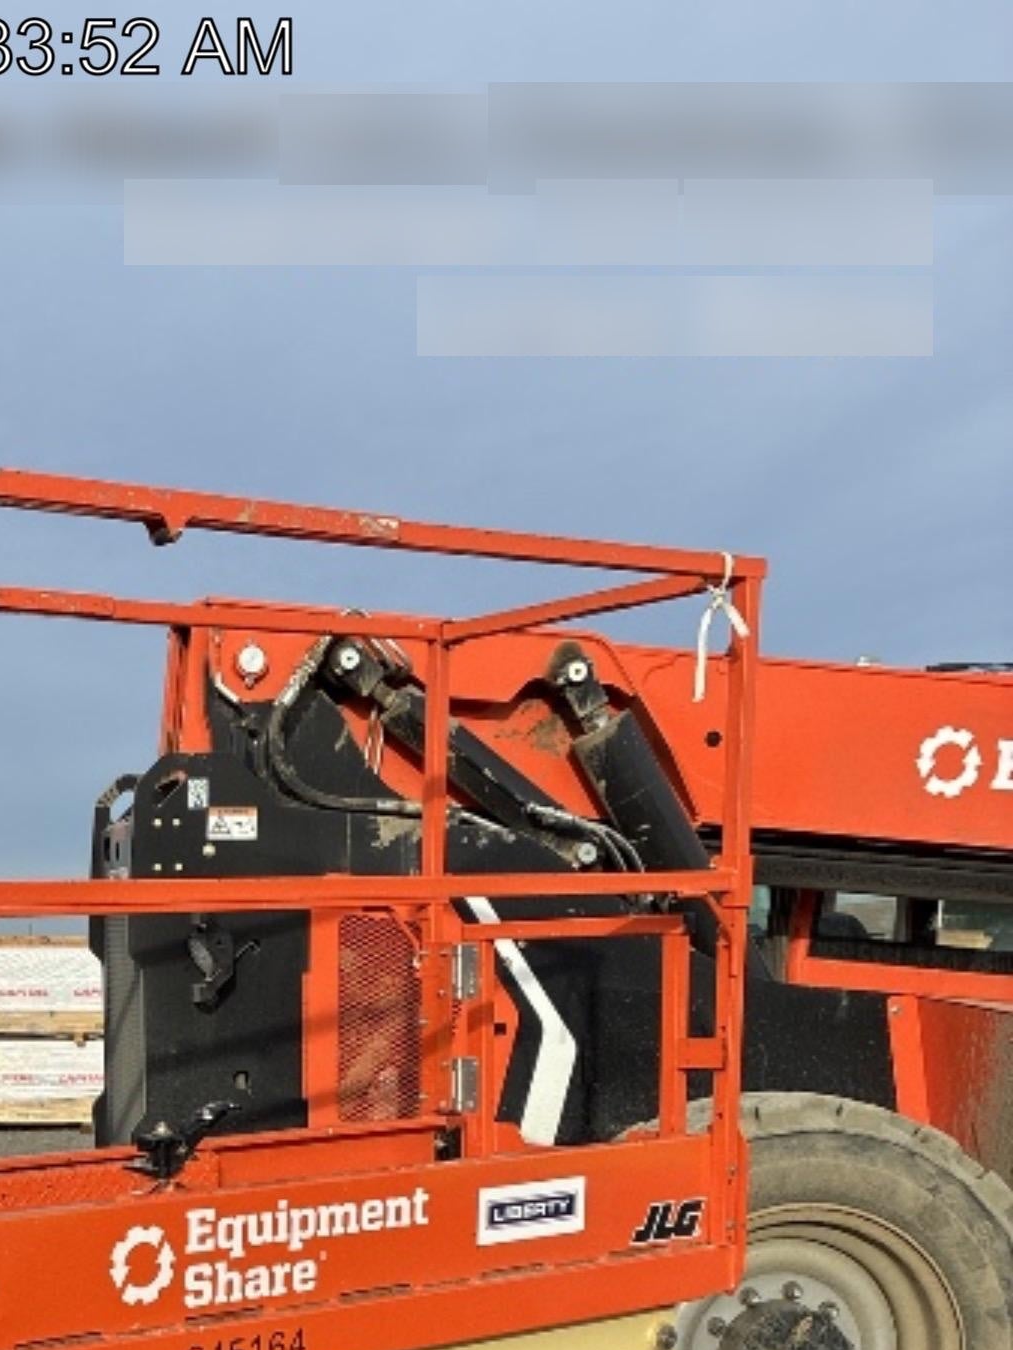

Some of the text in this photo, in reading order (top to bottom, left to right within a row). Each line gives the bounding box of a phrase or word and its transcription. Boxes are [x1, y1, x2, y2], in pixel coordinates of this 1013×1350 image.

[185, 1187, 429, 1258] Equipment
[630, 1197, 707, 1244] JLG
[184, 1259, 317, 1308] Share
